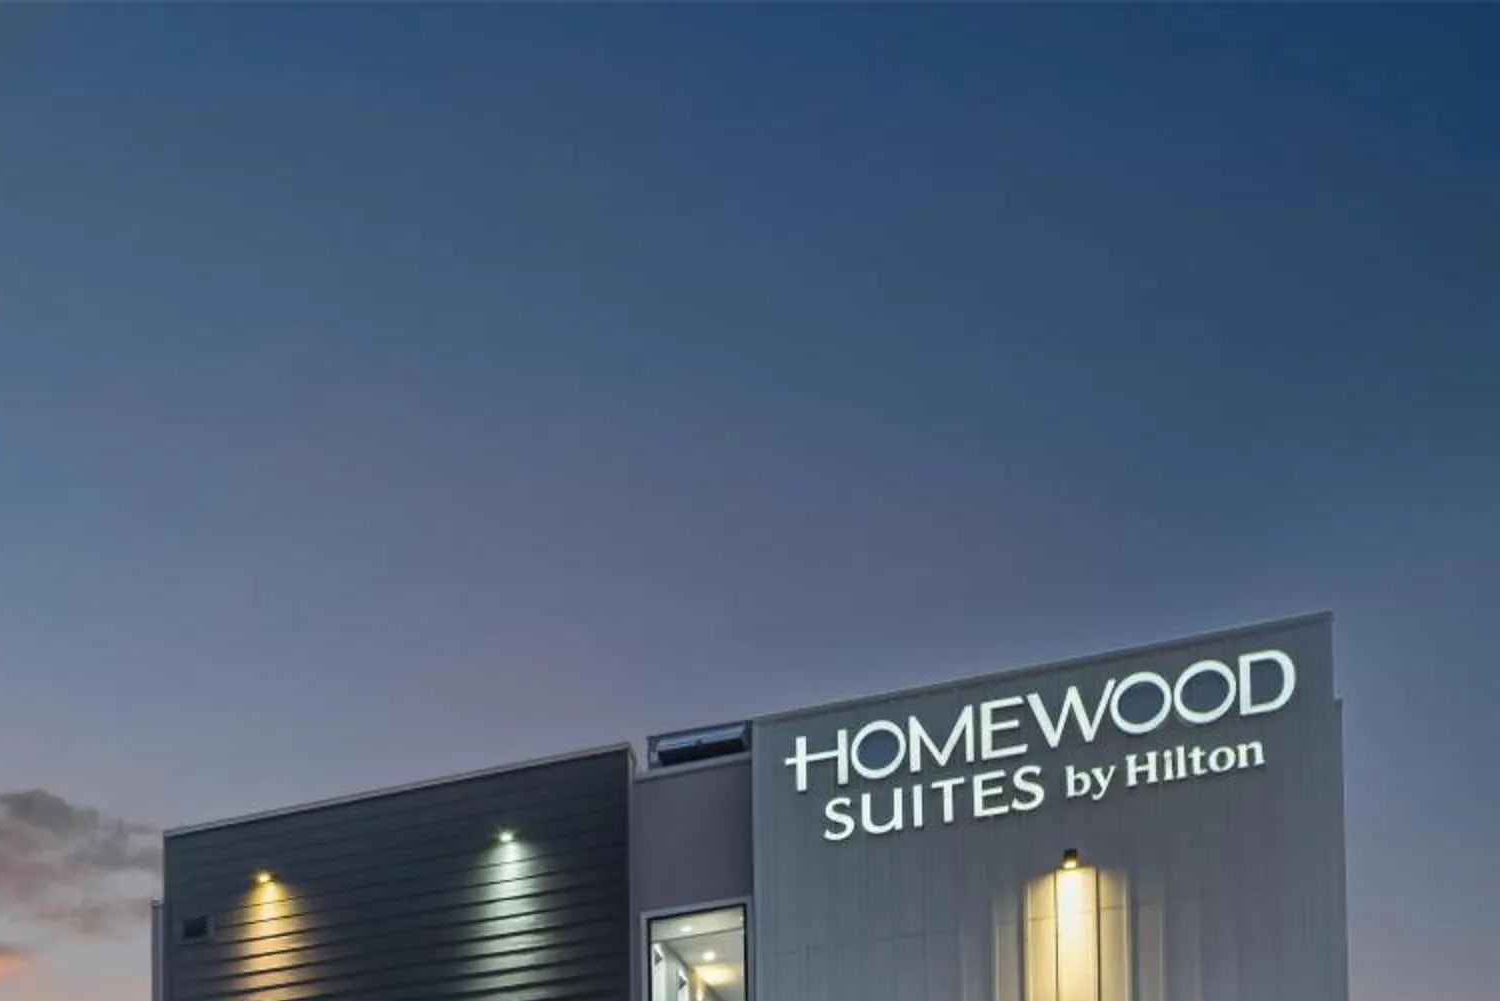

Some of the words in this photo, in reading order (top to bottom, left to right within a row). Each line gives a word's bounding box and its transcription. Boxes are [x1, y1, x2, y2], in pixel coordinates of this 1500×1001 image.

[784, 648, 1297, 792] HOMEWOOD
[823, 764, 1046, 842] SUITES
[1065, 764, 1116, 801] by
[1125, 740, 1266, 787] Hilton
